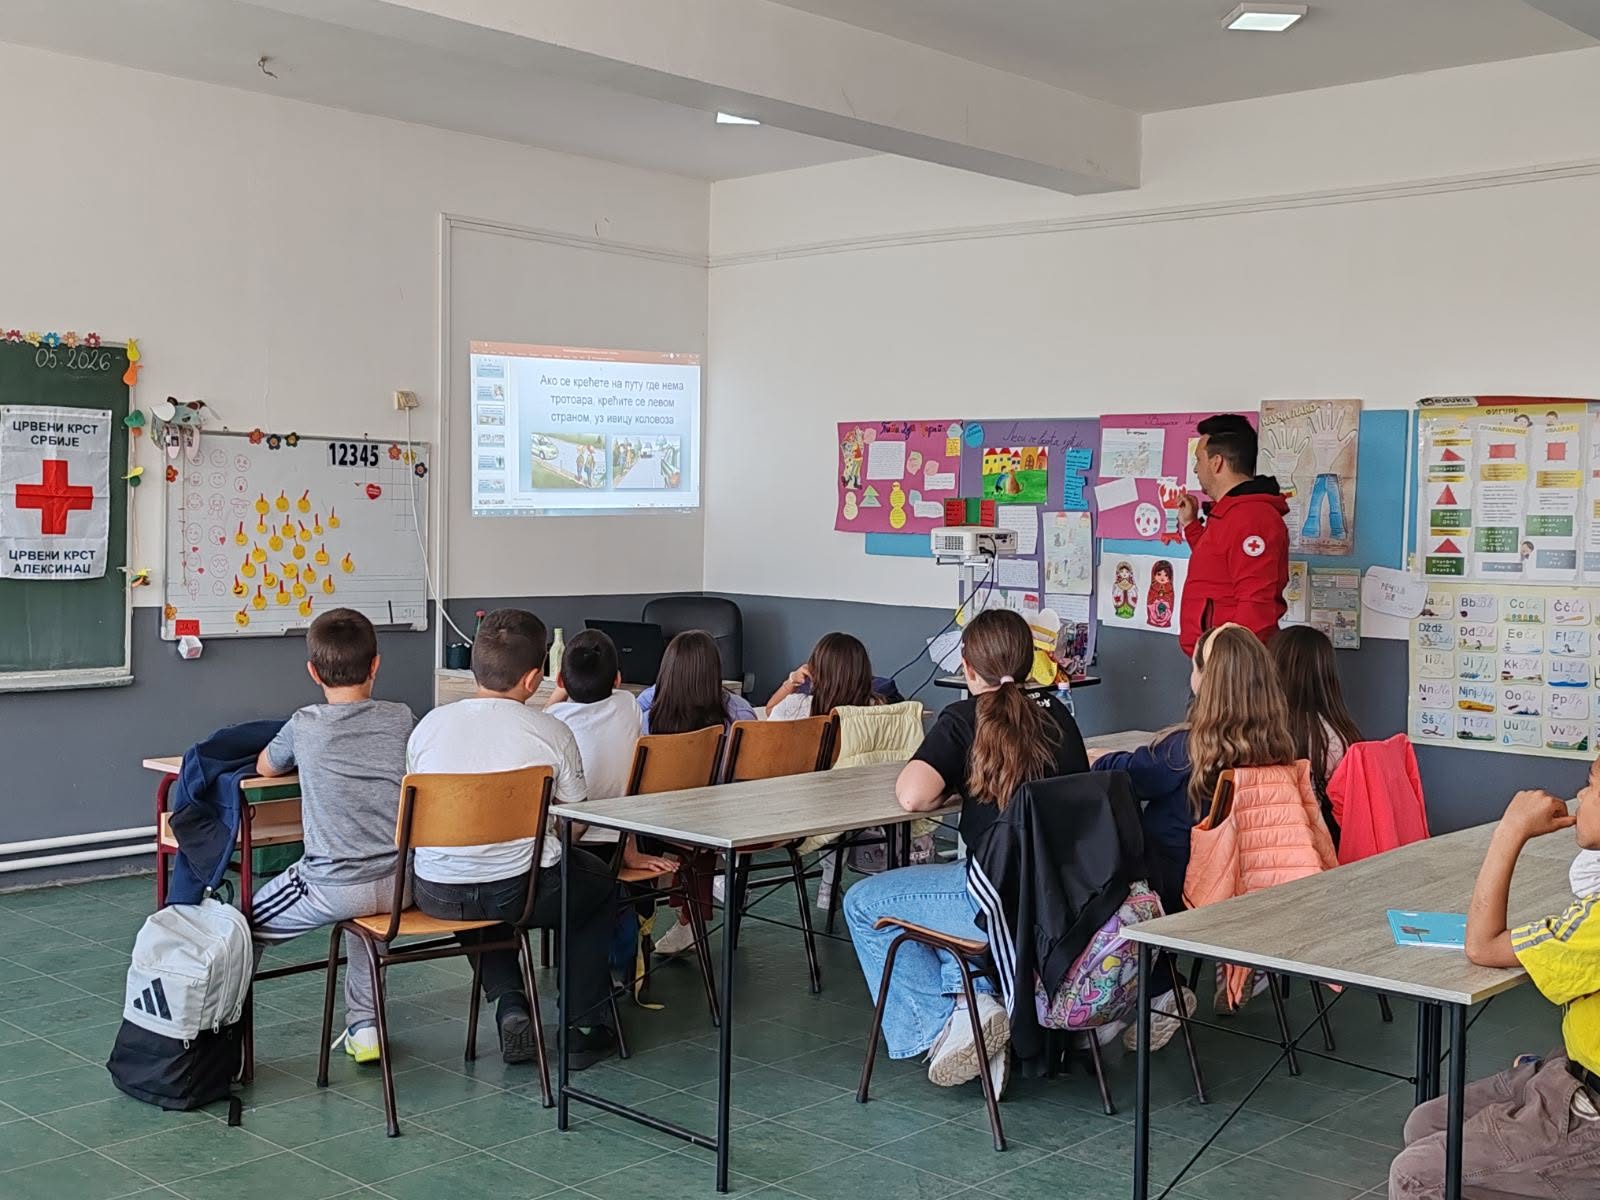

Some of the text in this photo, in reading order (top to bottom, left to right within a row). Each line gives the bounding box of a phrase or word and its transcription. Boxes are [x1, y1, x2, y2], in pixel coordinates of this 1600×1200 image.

[540, 374, 684, 391] Ако се крећете на путу где нема
[550, 395, 675, 408] тротоара, крећите се левом
[550, 413, 674, 426] страном, уз ивицу коловоза
[13, 421, 98, 434] ЦРВЕНИ КРСТ
[30, 435, 80, 447] СРБИЈЕ
[9, 550, 96, 561] ЦРВЕНИ КРСТ
[14, 563, 91, 574] АЛЕКСИНАЦ
[1461, 598, 1476, 607] Bb
[1510, 599, 1524, 609] Cc
[1554, 600, 1570, 612] Čč
[1418, 623, 1443, 632] Dždž
[1460, 627, 1475, 636] Đđ
[1508, 629, 1523, 638] Ee
[1555, 631, 1567, 641] Ff
[1425, 654, 1432, 664] Ii
[1463, 657, 1473, 668] Jj
[1504, 659, 1518, 669] Kk
[1552, 662, 1562, 672] Ll
[1419, 684, 1433, 693] Nn
[1459, 686, 1477, 698] Njnj
[1505, 690, 1521, 700] Oo
[1552, 694, 1567, 704] Pp
[1421, 712, 1434, 724] Šš
[1462, 717, 1473, 727] Tt
[1504, 720, 1518, 730] Uu
[1550, 725, 1565, 735] Vv
